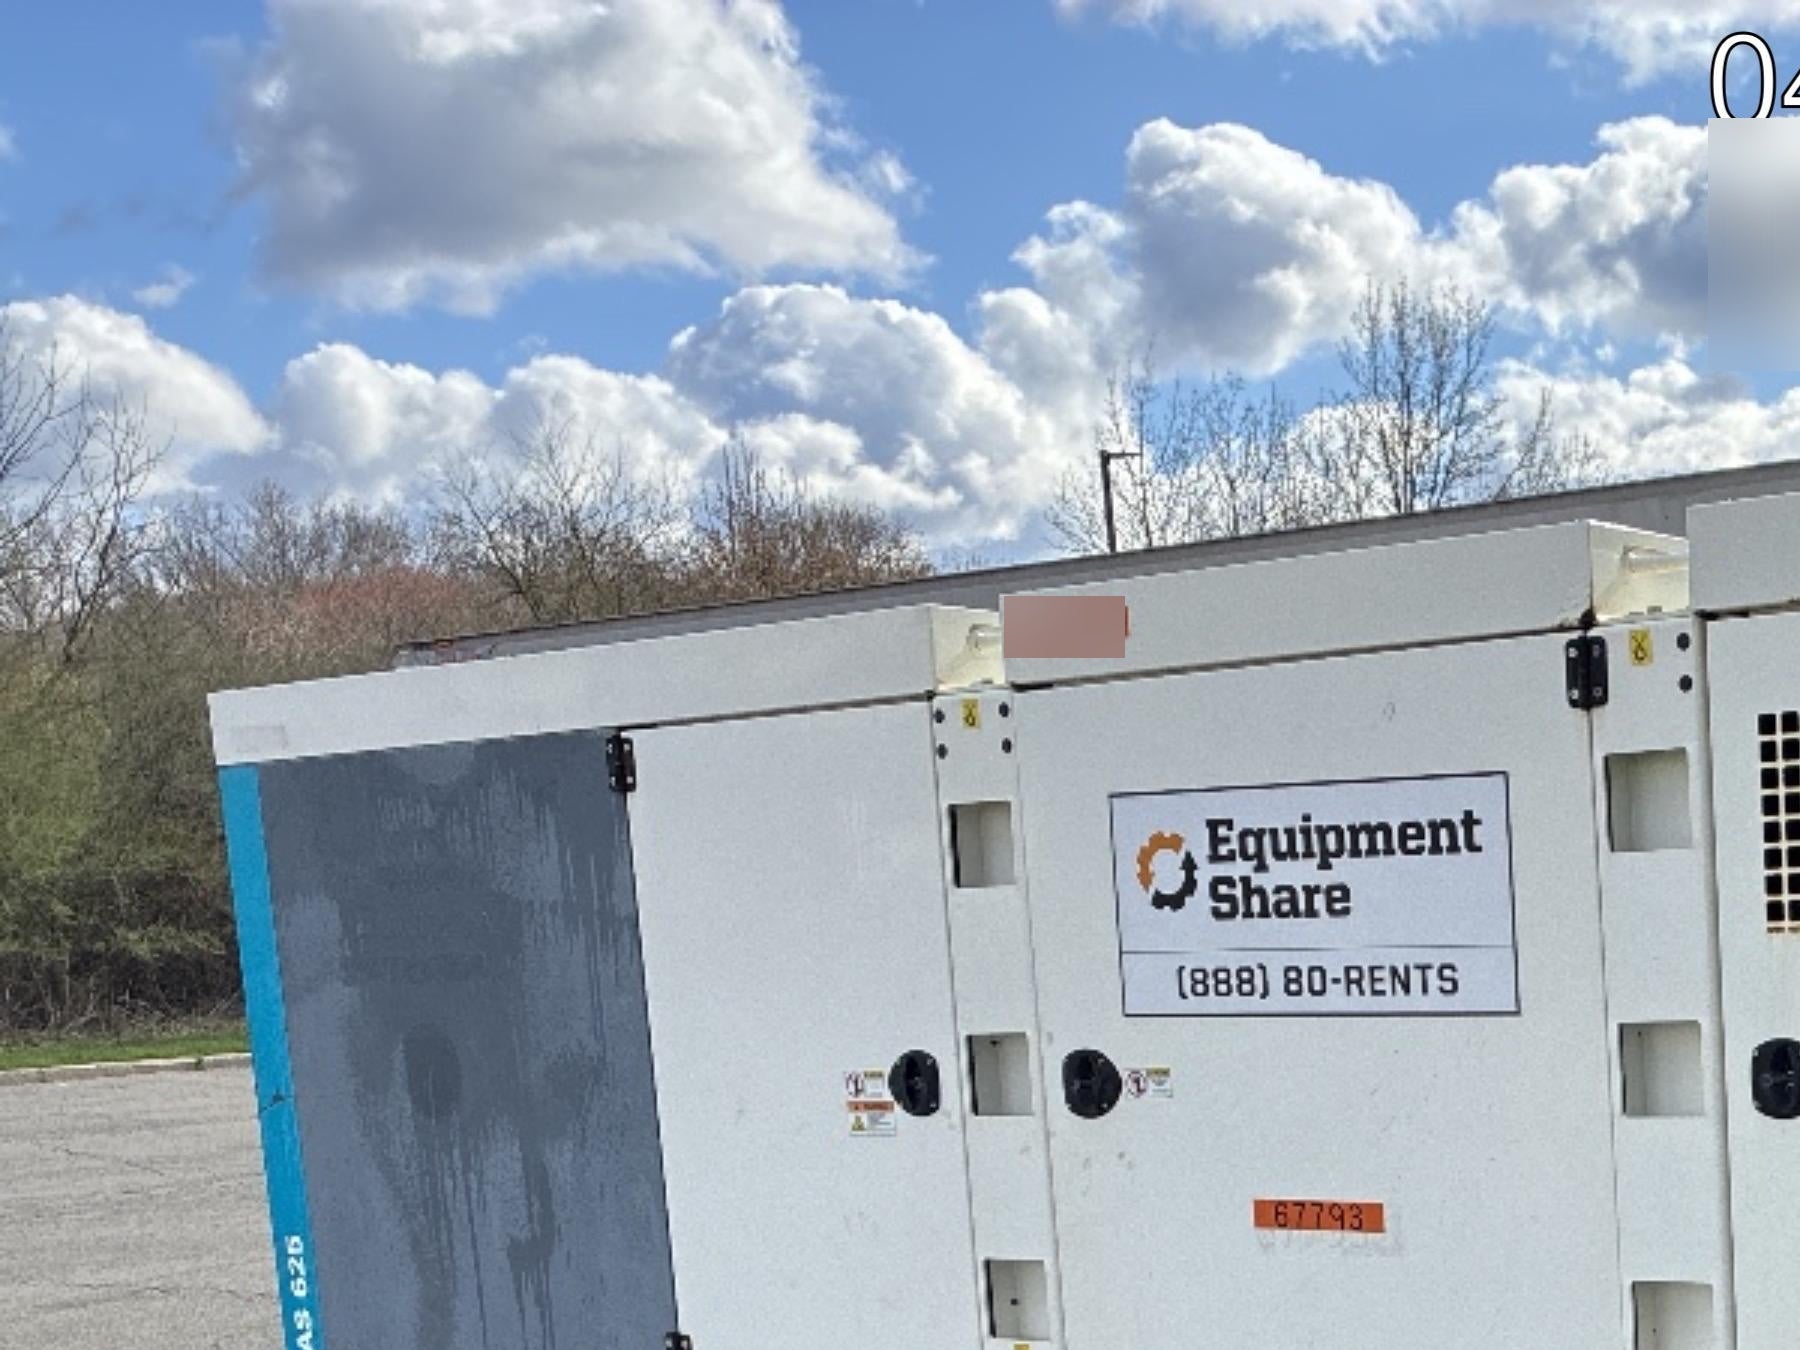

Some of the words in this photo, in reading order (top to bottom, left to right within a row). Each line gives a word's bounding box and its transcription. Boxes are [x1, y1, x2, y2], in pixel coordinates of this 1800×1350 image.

[1205, 810, 1483, 872] Equipment
[1208, 875, 1352, 921] Share
[1177, 963, 1270, 999] (888)
[1283, 962, 1459, 997] 80-RENTS
[1273, 1202, 1363, 1231] 67793
